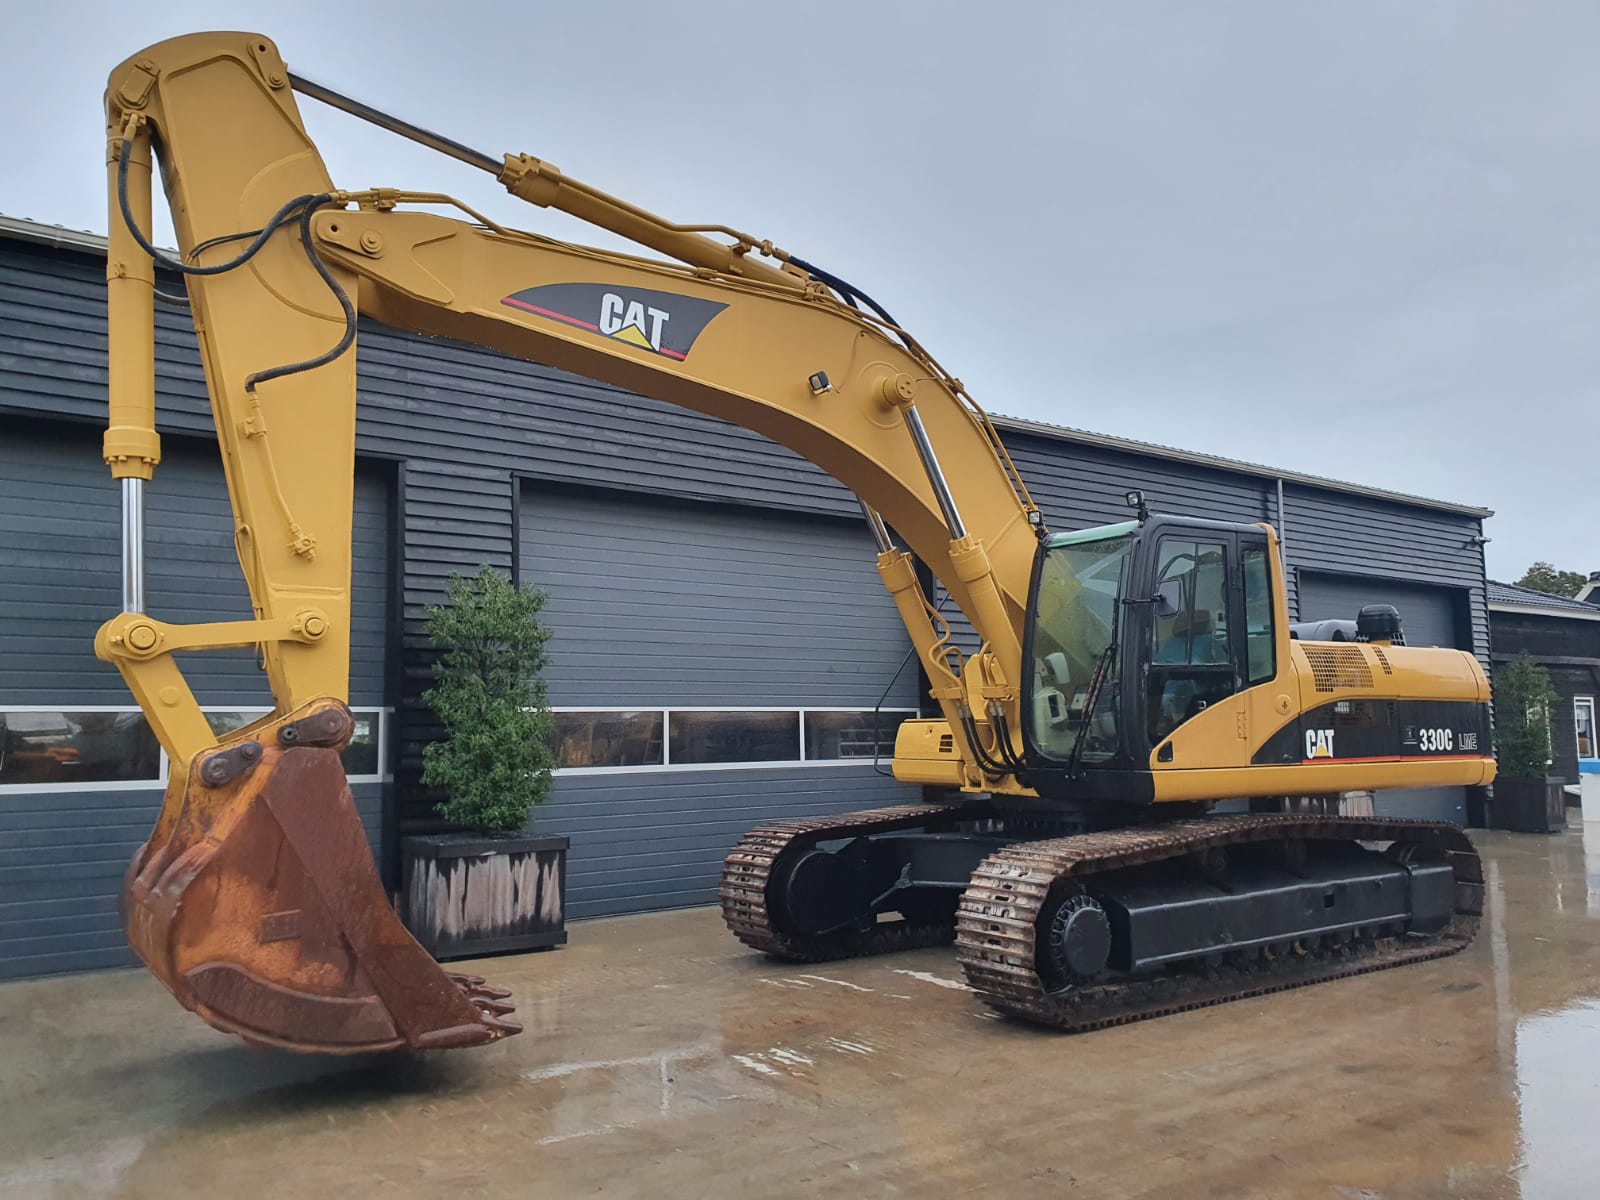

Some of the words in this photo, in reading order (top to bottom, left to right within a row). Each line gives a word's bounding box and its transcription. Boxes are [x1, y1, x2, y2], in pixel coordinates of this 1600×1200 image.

[600, 293, 669, 352] CAT
[1305, 729, 1335, 758] CAT
[1420, 728, 1453, 751] 330C
